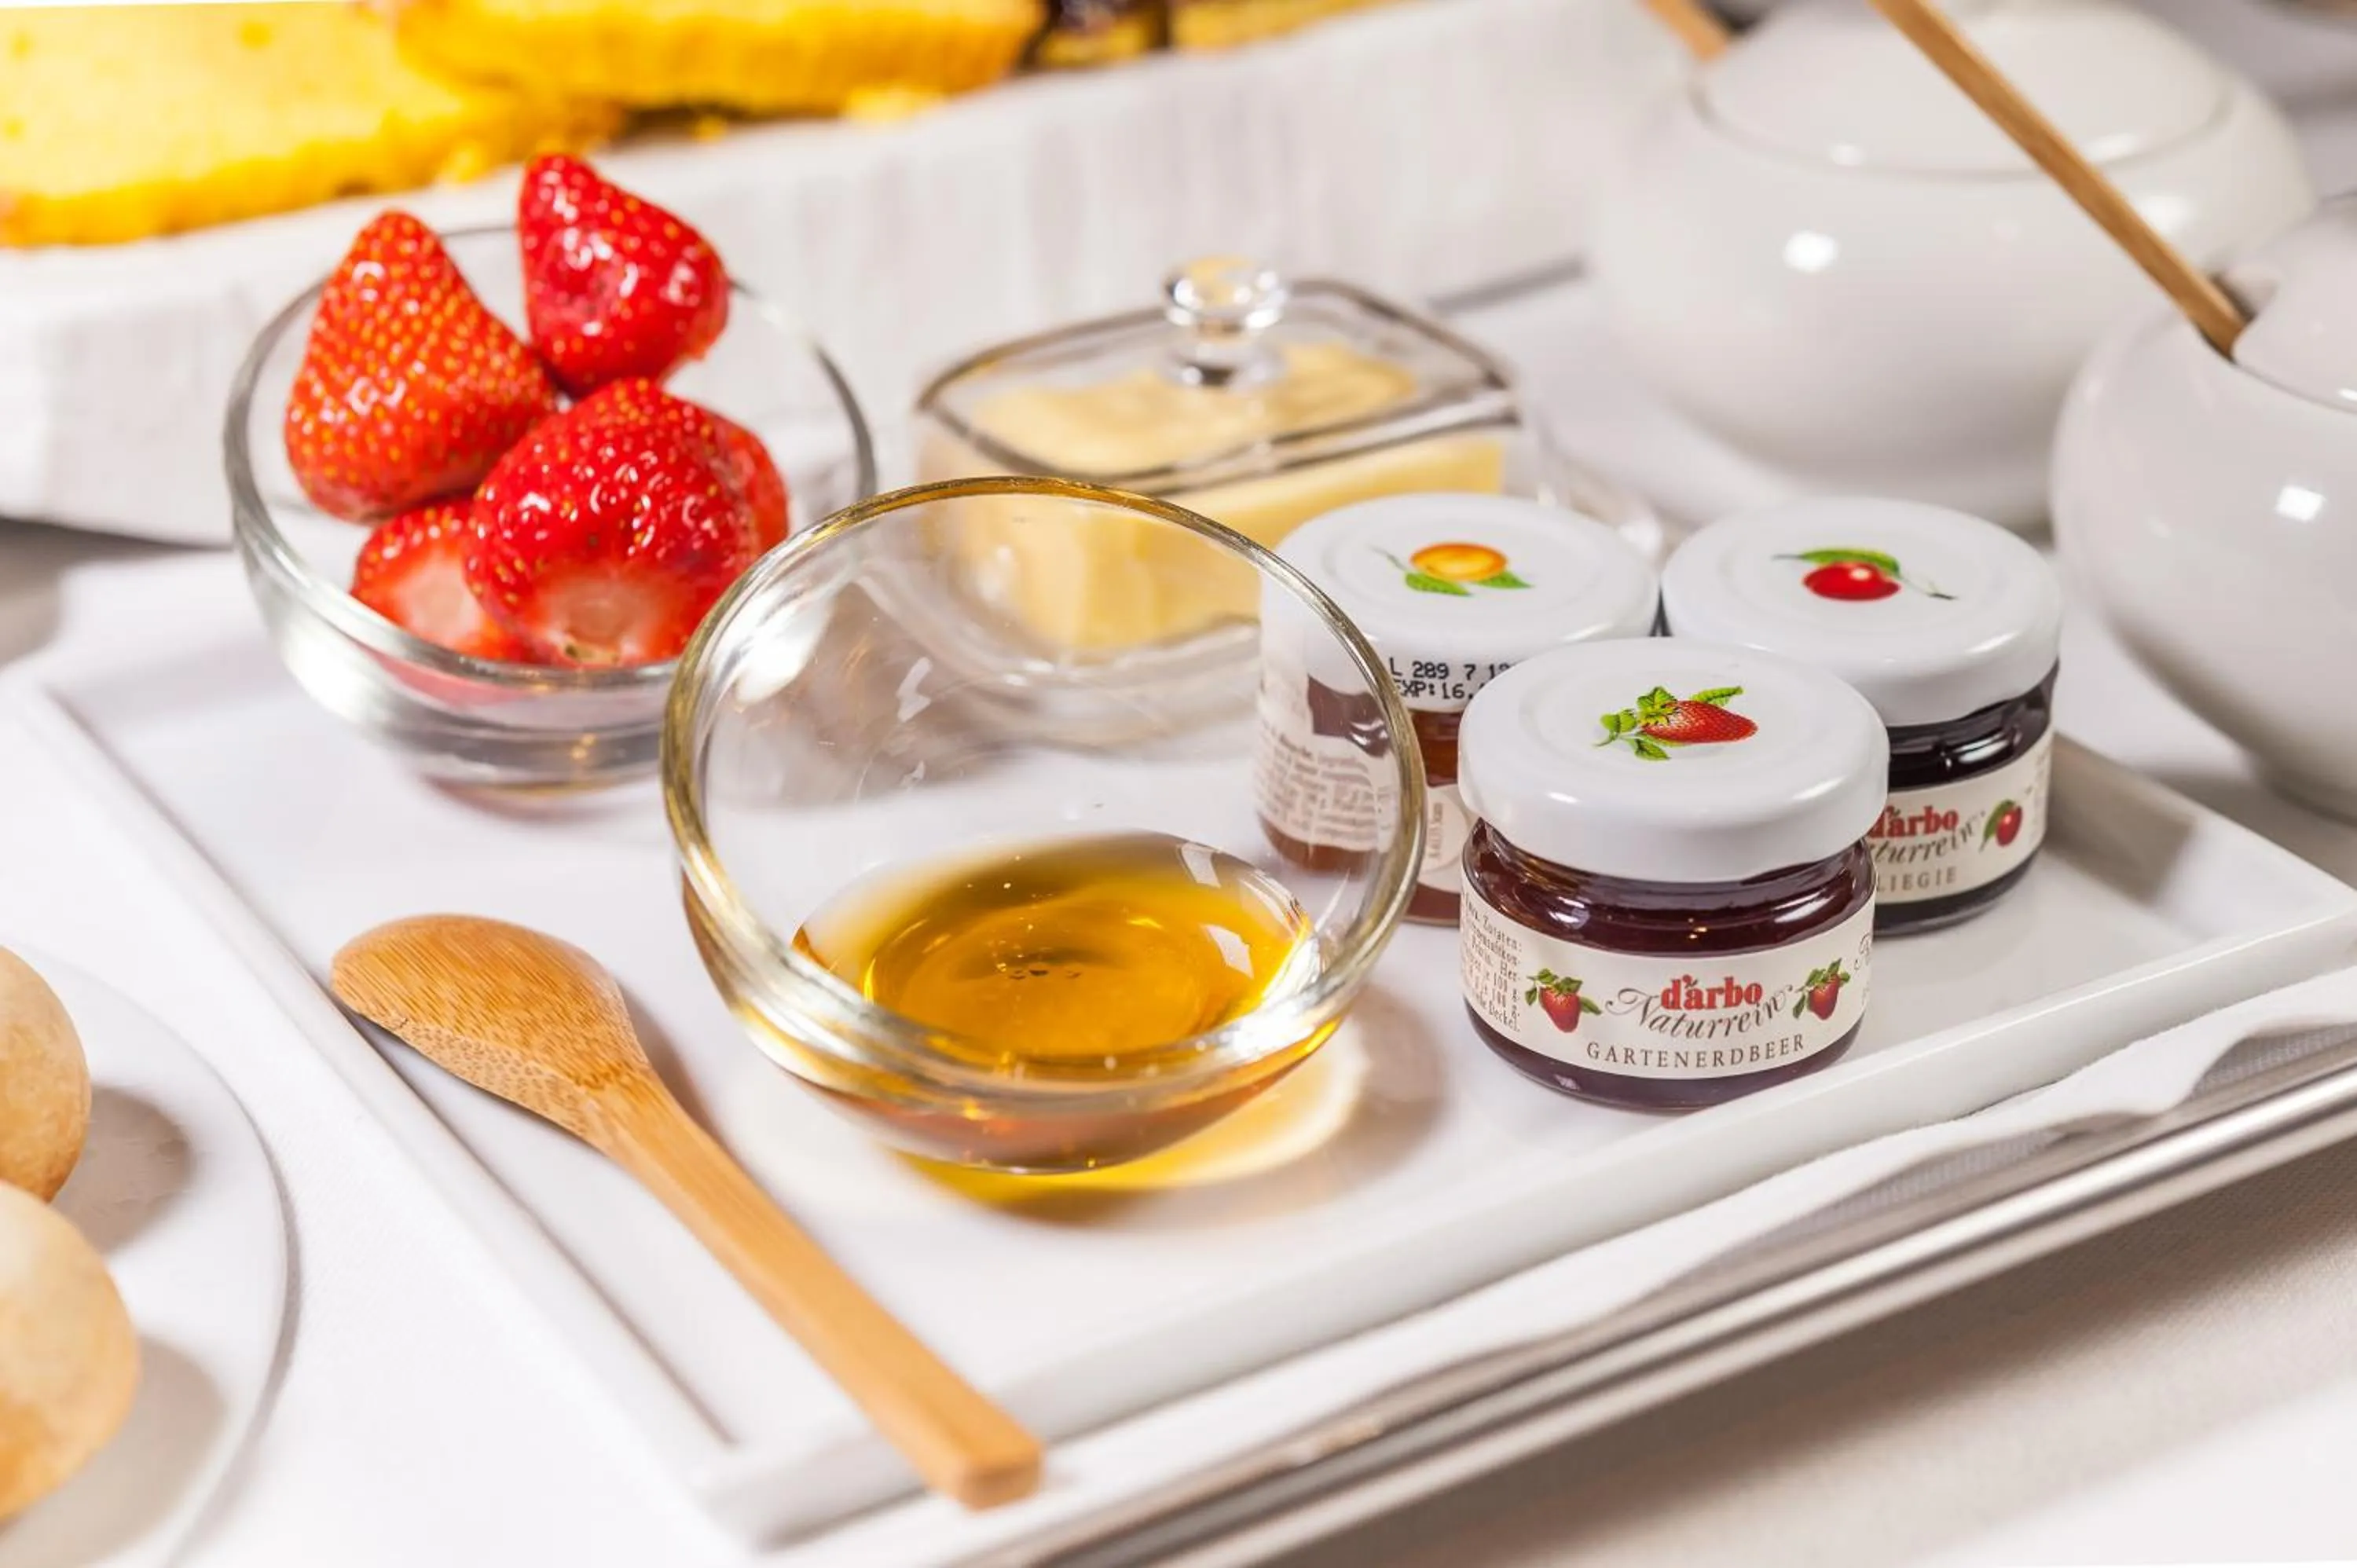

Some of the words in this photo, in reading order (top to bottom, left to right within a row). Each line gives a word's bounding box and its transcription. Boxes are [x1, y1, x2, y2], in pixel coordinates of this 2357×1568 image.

[1388, 657, 1403, 677] L
[1412, 661, 1450, 680] 289
[1464, 664, 1476, 680] 7
[1870, 810, 1986, 864] turrein
[1876, 866, 1957, 893] LIEGIE
[1605, 984, 1794, 1039] Naturrein
[1586, 1034, 1805, 1068] GARTENERDBEER
